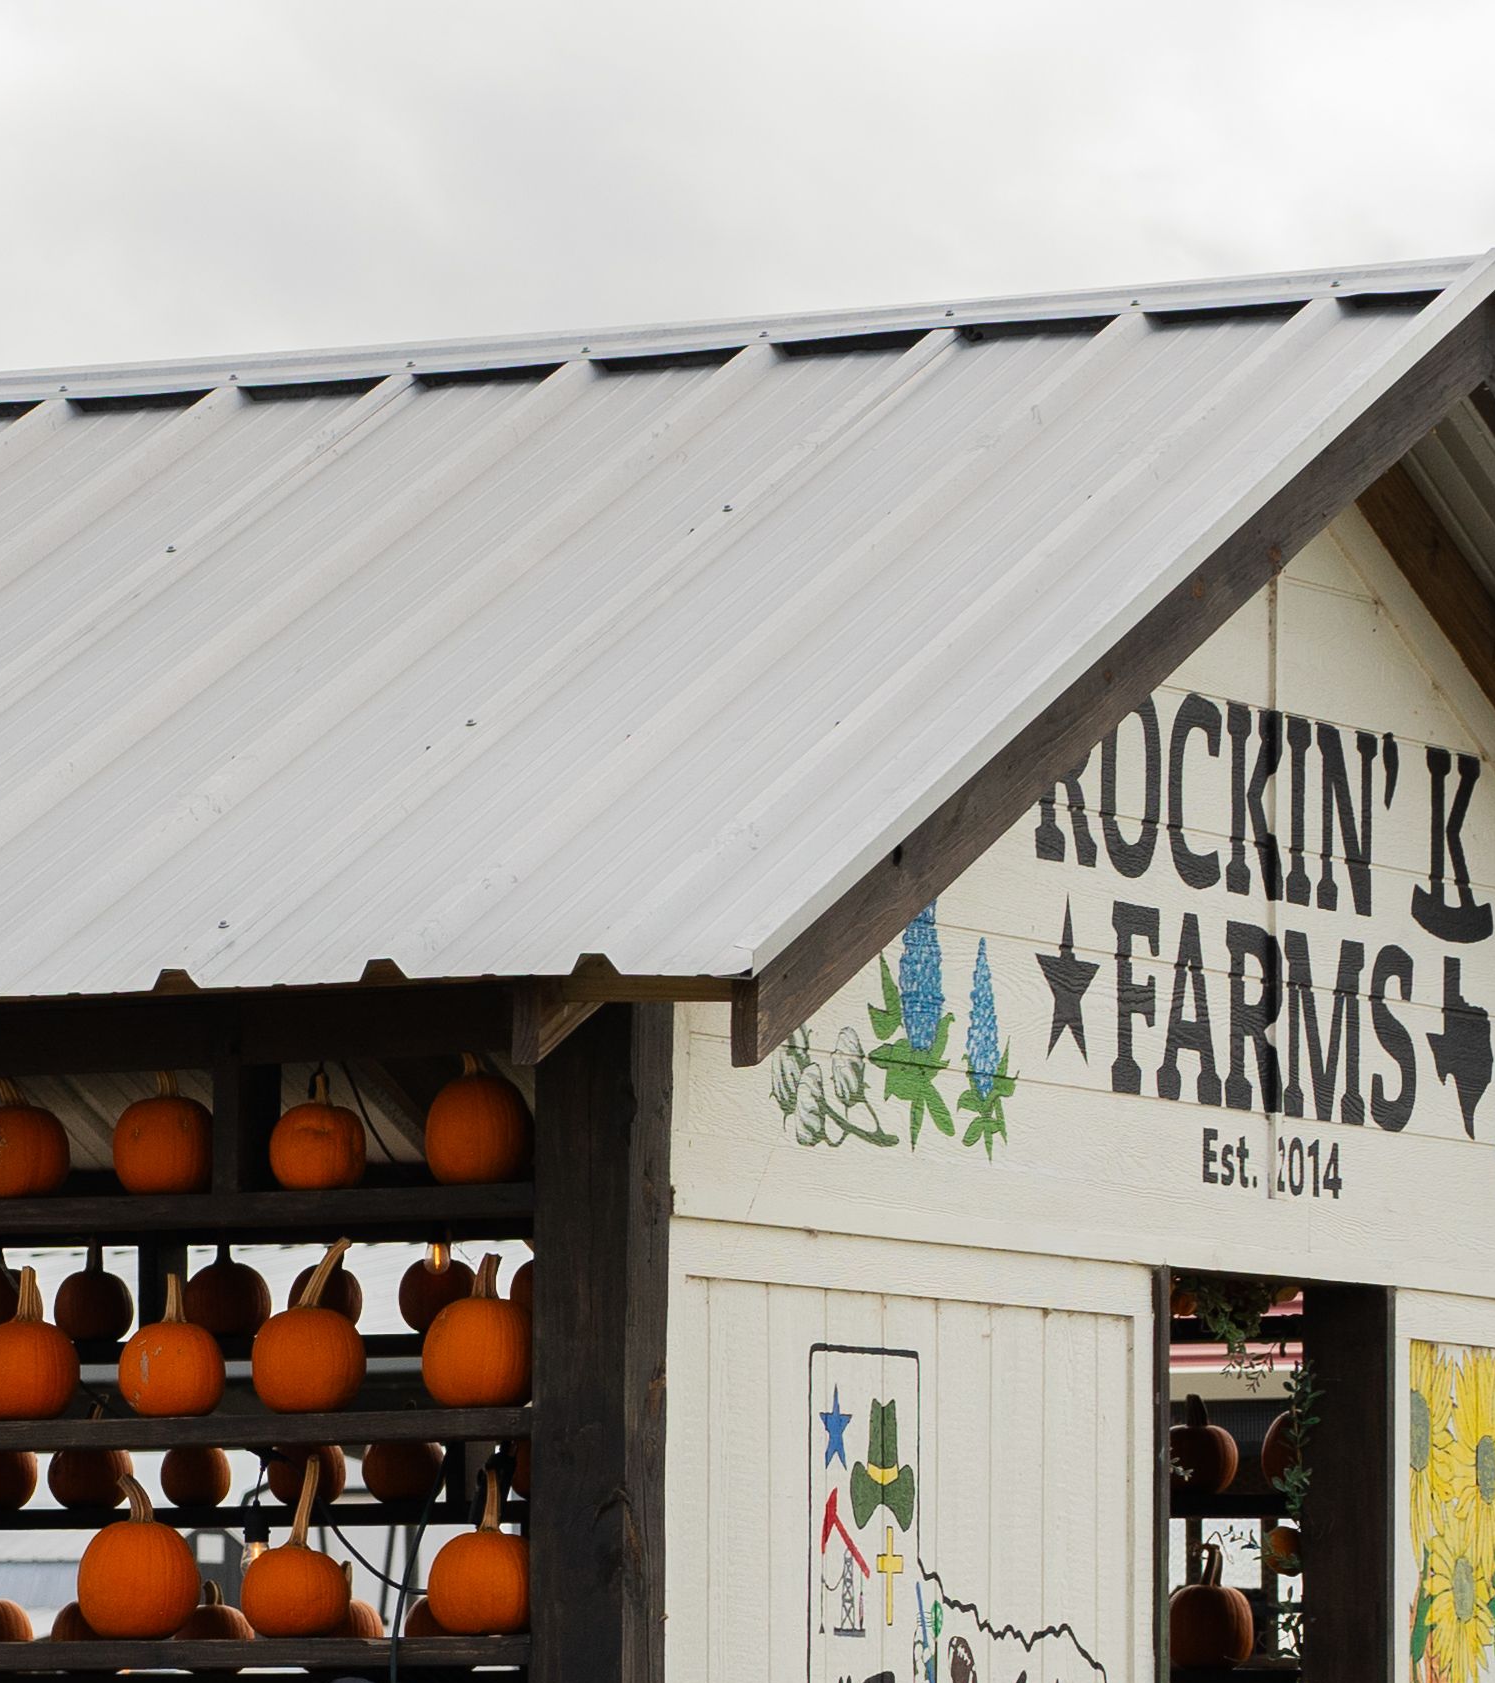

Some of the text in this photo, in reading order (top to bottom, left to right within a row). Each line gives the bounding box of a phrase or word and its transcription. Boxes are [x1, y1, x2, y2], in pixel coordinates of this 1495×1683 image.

[1411, 745, 1494, 944] K
[1111, 900, 1418, 1133] FARMS
[1202, 1126, 1343, 1200] Est. 2014
